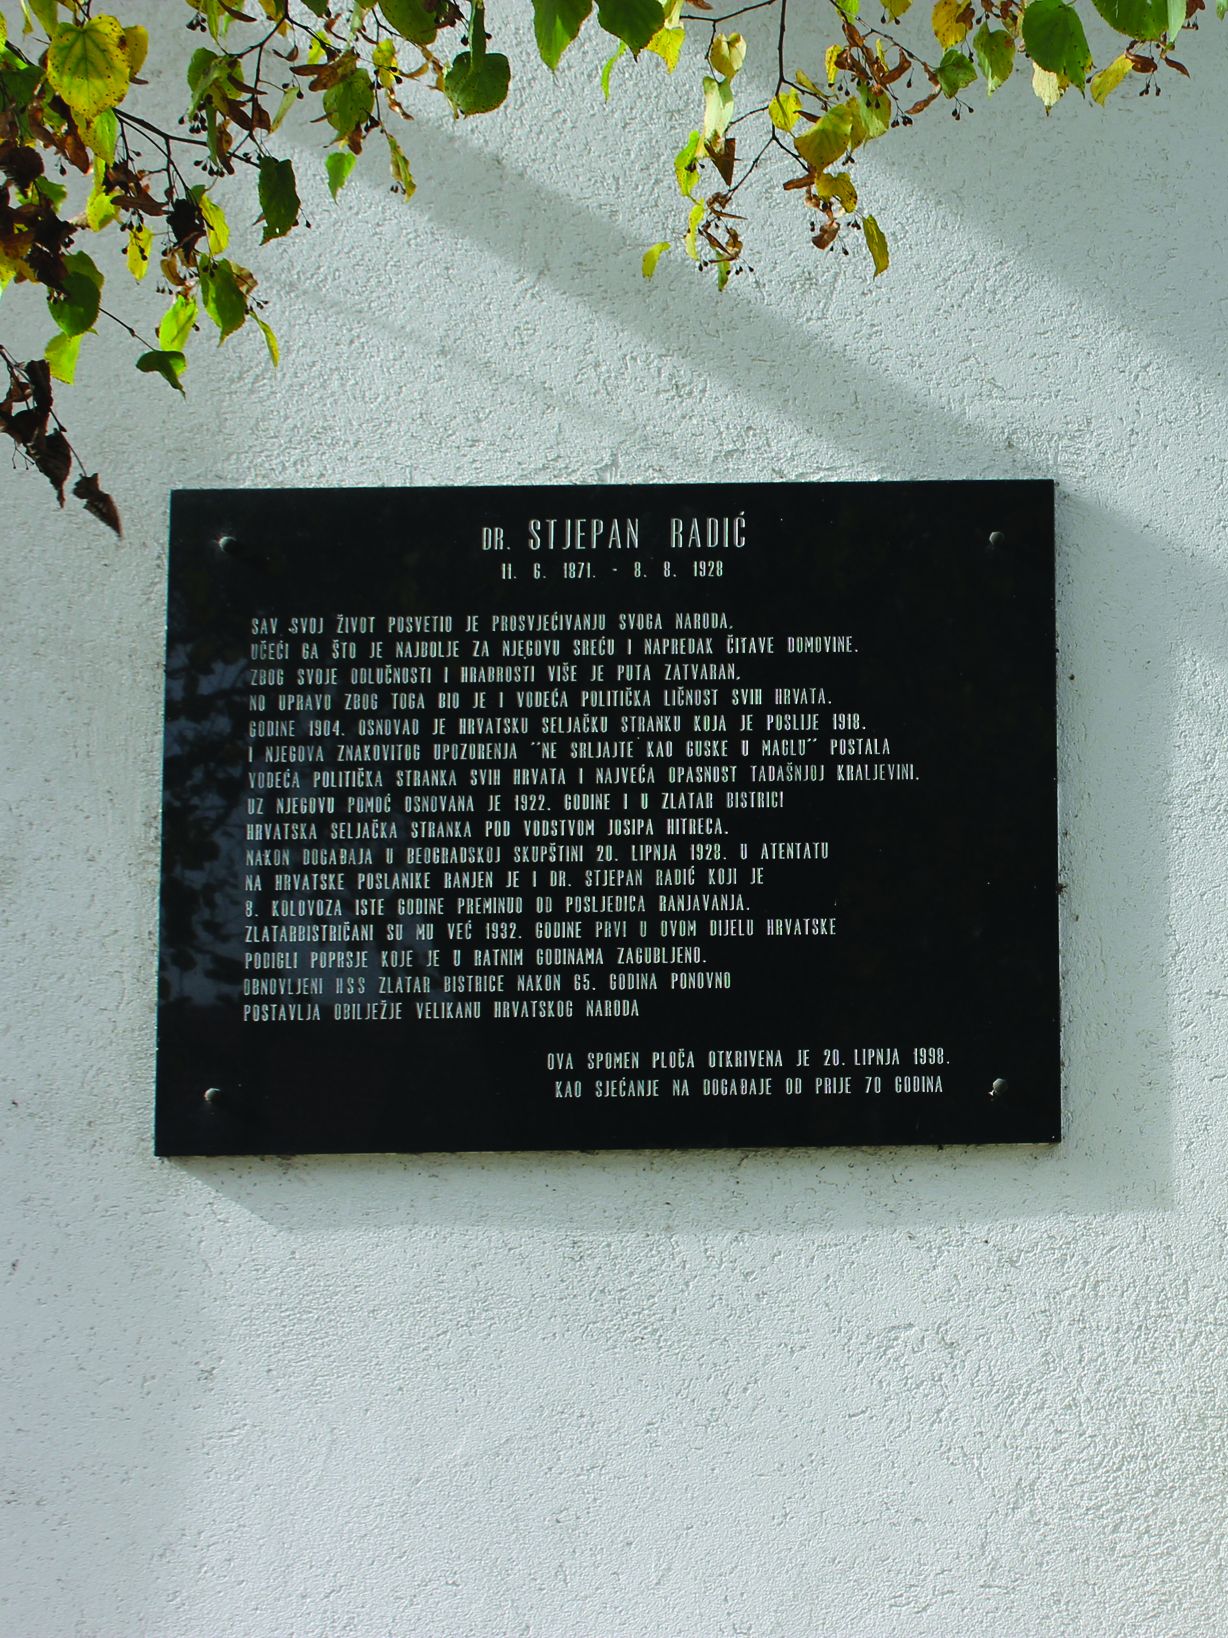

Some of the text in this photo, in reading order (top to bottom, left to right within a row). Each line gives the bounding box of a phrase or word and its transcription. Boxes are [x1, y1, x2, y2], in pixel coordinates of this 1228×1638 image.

[481, 510, 746, 551] DR. STJEPAN RADIĆ
[500, 558, 724, 581] 11. 6. 1871. 8. 8. 1928
[251, 617, 278, 636] SAV
[336, 613, 374, 634] ŽIVOT
[387, 615, 453, 634] POSVETIO
[491, 610, 606, 633] PROSVJEĆIVANJU
[618, 612, 663, 631] SVOGA
[250, 633, 859, 661] UČEĆI GA ŠTO NAJBOLJE NJEGOVU SREĆU NAPREDAK ČITAVE DOMOVINE.
[250, 668, 284, 687] ZBOG
[296, 667, 338, 686] SVOJE
[350, 663, 432, 685] ODLUČNOSTI
[460, 665, 535, 684] HRABROSTI
[547, 661, 577, 683] VIŠE
[616, 663, 651, 682] PUTA
[278, 685, 832, 712] UPRAVO ZBOG TOGA BIO VODEĆA POLITIČKA LIČNOST SVIH HRVATA.
[249, 712, 867, 739] GODINE 1904. OSNOVAO HRVATSKU SELJAČKU STRANKU KOJA POSLIJE 1918.
[265, 737, 891, 763] NJEGOVA ZNAKOVITOG UPOZORENJA SRLJAJTE KAO GUSKE POSTALA
[248, 761, 920, 789] VODEĆA POLITIČKA STRANKA SVIH HRVATA NAJVEĆA OPASNOST TADAŠNJOJ KRALJEVINI.
[247, 790, 784, 816] UZ NJEGOVU POMOĆ OSNOVANA 1922. GODINE ZLATAR BISTRICI
[246, 817, 729, 841] HRVATSKA SELJAČKA STRANKA POD VODSTVOM JOSIPA HITRECA.
[246, 848, 290, 867] NAKON
[406, 845, 501, 865] BEOGRADSKOJ
[513, 841, 584, 864] SKUPŠTINI
[596, 844, 619, 863] 20.
[630, 843, 677, 862] LIPNJA
[689, 842, 727, 862] 1928.
[760, 841, 829, 860] ATENTATU
[244, 864, 737, 892] NA HRVATSKE POSLANIKE RANJEN DR. STJEPAN RADIĆ KOJI
[245, 893, 750, 918] 8. KOLOVOZA ISTE GODINE PREMINUO OD POSLJEDICA RANJAVANJA.
[244, 917, 836, 943] ZLATARBISTRIČANI SU MU VEĆ 1932. GODINE PRVI OVOM DIJELU HRVATSKE
[244, 945, 707, 970] PODIGLI POPRSJE KOJE RATNIM GODINAMA ZAGUBLJENO.
[243, 971, 731, 996] OBNOVLJENI ZLATAR BISTRICE NAKON 65. GODINA PONOVNO
[243, 998, 640, 1022] POSTAVLJA OBILJEŽJE VELIKANU HRVATSKOG NARODA
[546, 1046, 950, 1071] OVA SPOMEN PLOČA OTKRIVENA 20. LIPNJA 1998.
[554, 1080, 582, 1099] KAO
[594, 1076, 659, 1098] SJEĆANJE
[672, 1078, 690, 1097] NA
[785, 1077, 802, 1096] OD
[815, 1076, 851, 1095] PRIJE
[865, 1075, 882, 1094] 70
[894, 1075, 943, 1094] GODINA
